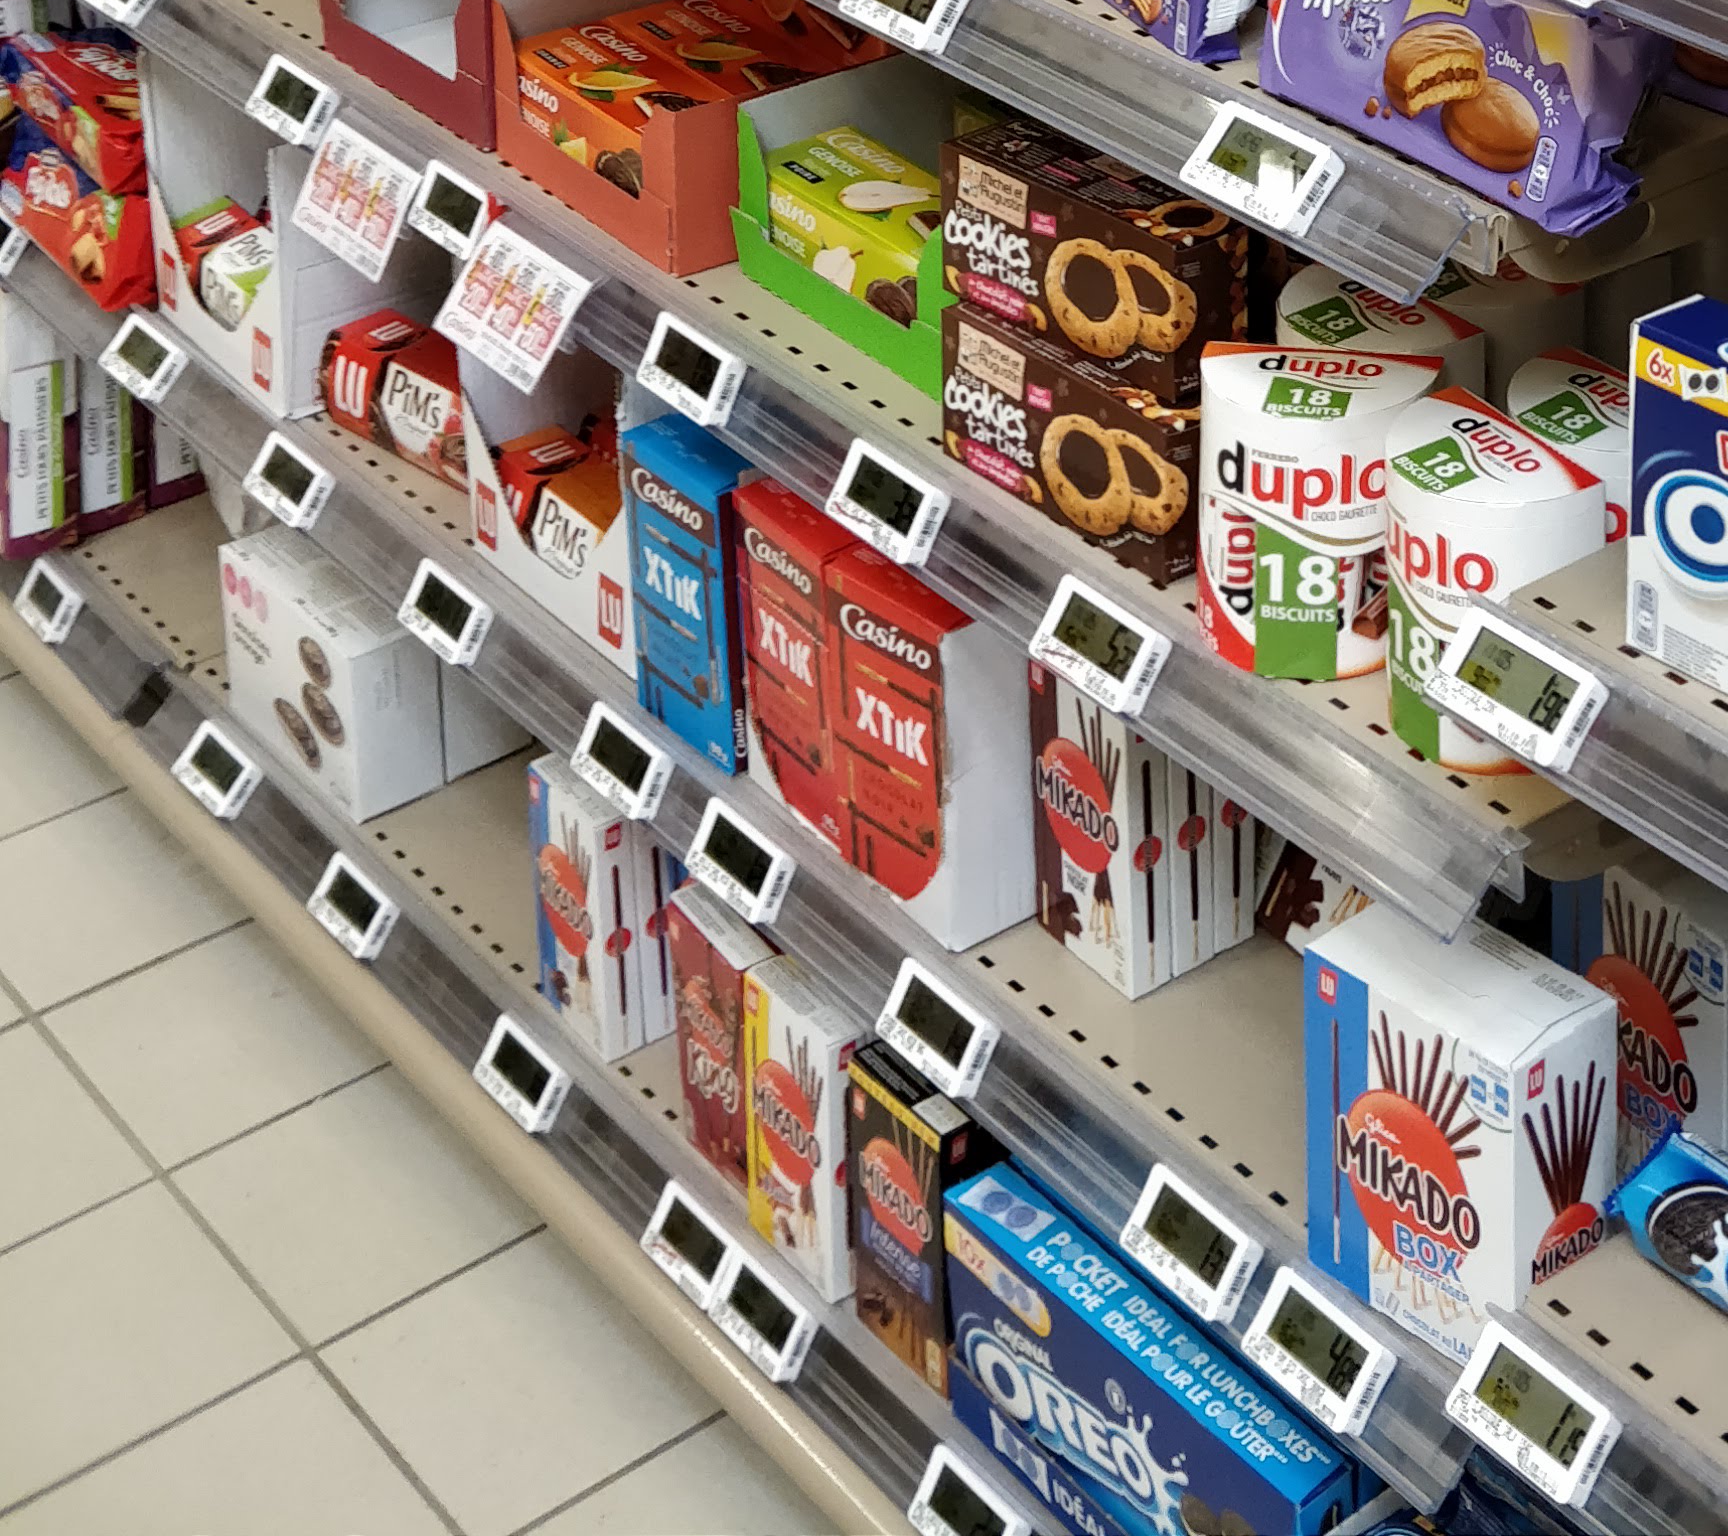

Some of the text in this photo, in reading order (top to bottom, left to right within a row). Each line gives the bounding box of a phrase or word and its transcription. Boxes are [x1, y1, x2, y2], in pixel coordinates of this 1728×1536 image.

[1495, 49, 1555, 117] Choc & Choc
[980, 170, 1024, 200] Michel et
[333, 357, 367, 419] LU
[1258, 353, 1385, 379] duplo
[1644, 350, 1674, 385] 6x
[1266, 401, 1343, 419] BISCUITS
[1287, 387, 1333, 408] 18
[1451, 413, 1542, 474] duplo
[1258, 551, 1337, 606] 18
[1260, 604, 1337, 624] BISCUITS
[1336, 1113, 1482, 1251] MIKADO
[1392, 1220, 1464, 1284] BOX
[1529, 1216, 1605, 1286] MIKADO
[1045, 1230, 1211, 1370] POCKET IDEAL FOR
